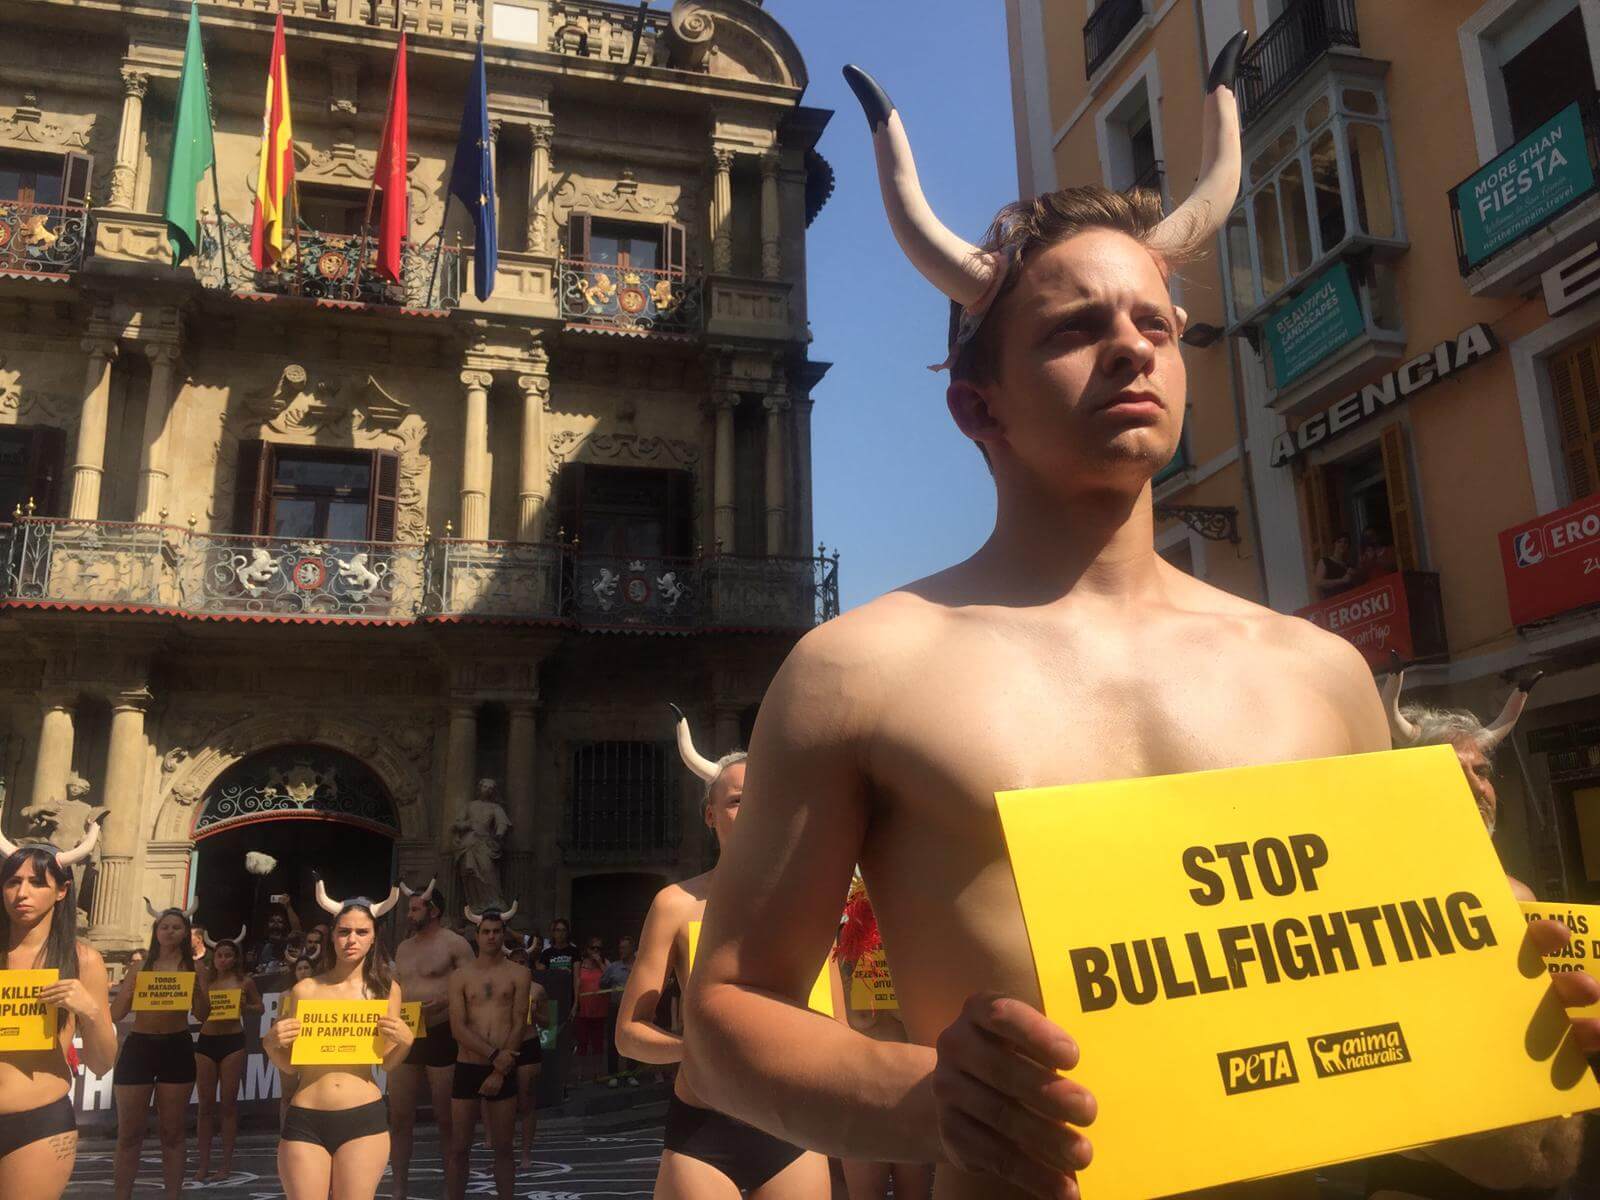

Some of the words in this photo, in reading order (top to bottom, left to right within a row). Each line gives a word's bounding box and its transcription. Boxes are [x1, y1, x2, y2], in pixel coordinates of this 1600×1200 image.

[1474, 159, 1518, 198] MORE
[1519, 126, 1563, 164] THAN
[1478, 147, 1568, 222] FIESTA
[1276, 281, 1336, 334] BEAUTIFUL
[1281, 294, 1339, 346] LANDSCAPES
[1270, 323, 1495, 467] AGENCIA
[1328, 592, 1389, 629] EROSKI
[1182, 833, 1329, 907] STOP
[1068, 891, 1498, 1013] BULLFIGHTING
[0, 1003, 47, 1016] PLONA
[301, 1027, 312, 1037] IN
[317, 1026, 380, 1037] PAMPLONA
[303, 1013, 338, 1023] BULLS
[342, 1013, 381, 1023] KILLED
[1343, 1031, 1400, 1056] anima
[1346, 1048, 1404, 1069] naturalis
